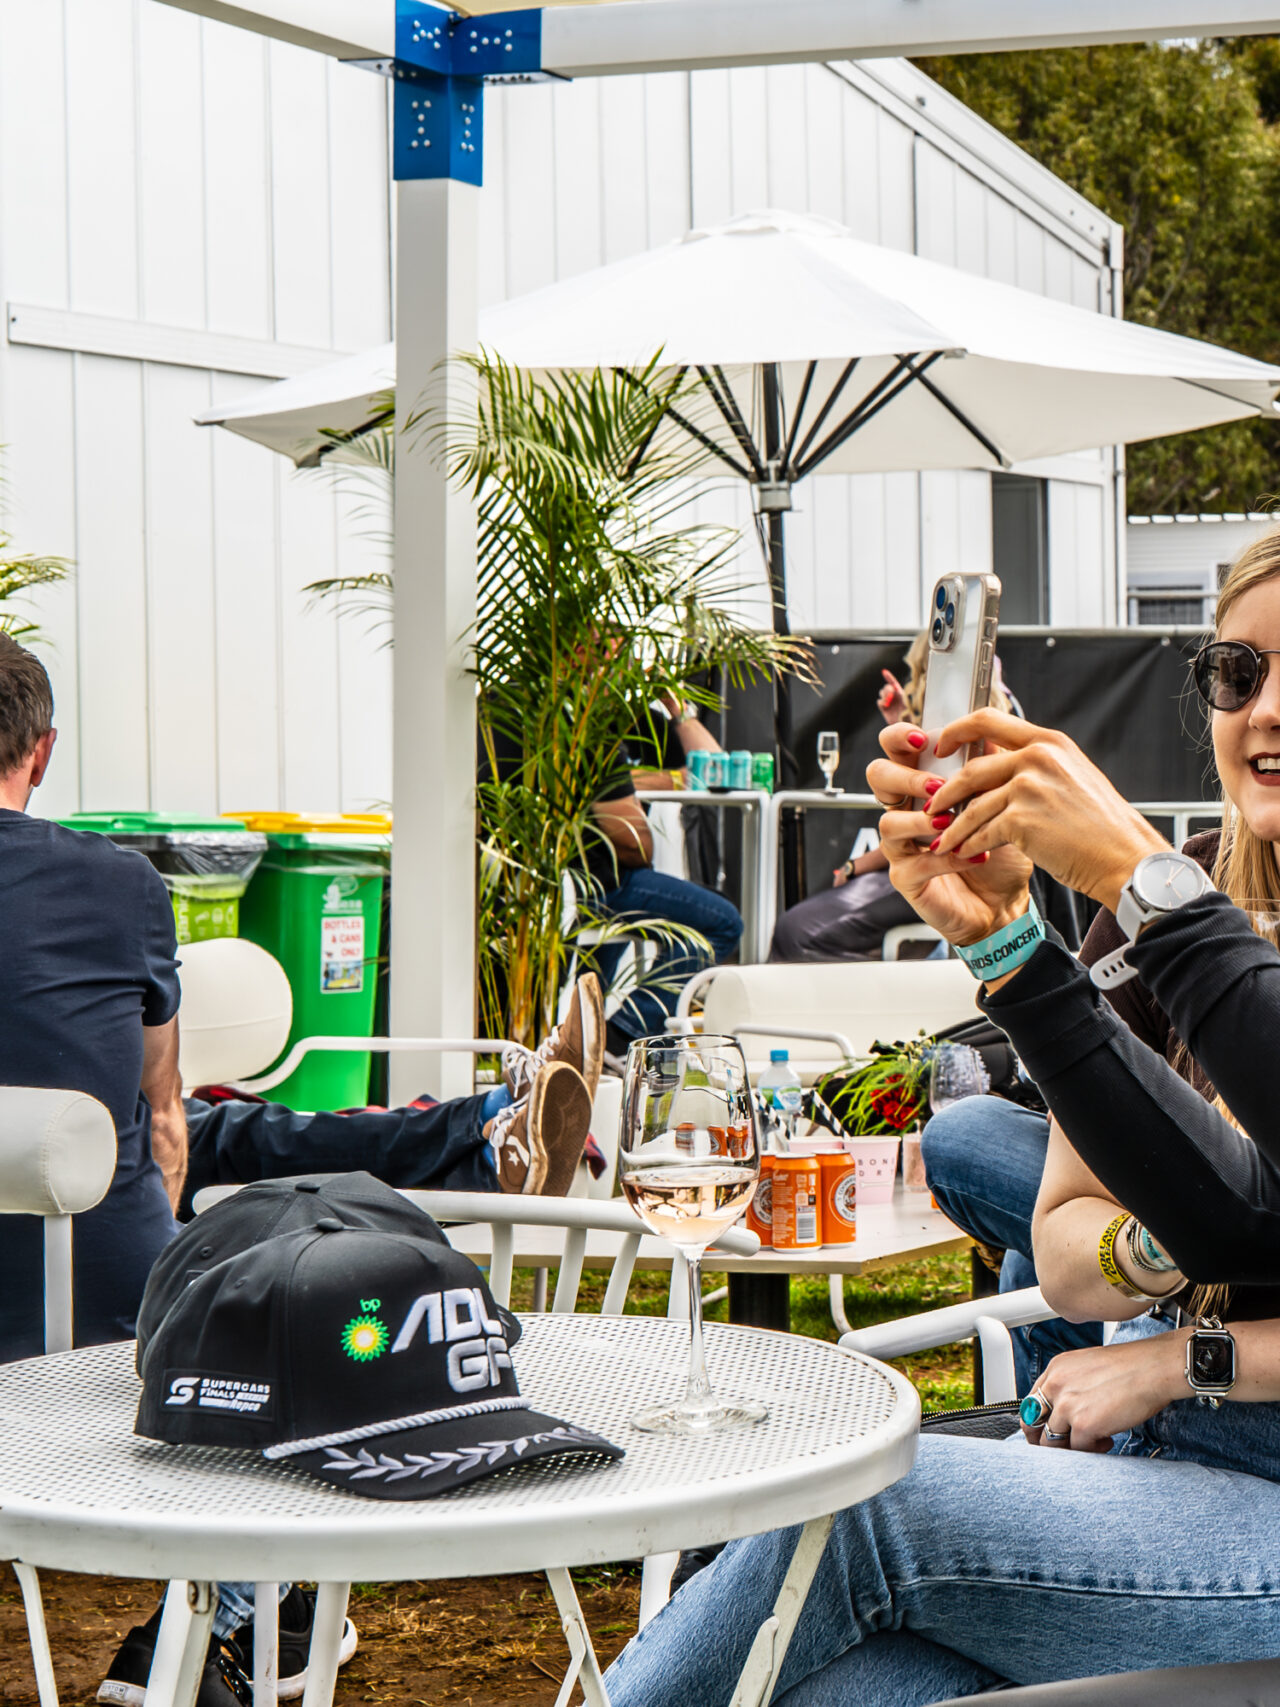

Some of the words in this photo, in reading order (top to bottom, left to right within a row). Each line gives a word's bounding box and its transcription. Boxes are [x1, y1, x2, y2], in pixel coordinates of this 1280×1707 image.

[993, 924, 1040, 963] CONCERT
[360, 1298, 381, 1312] bp
[200, 1388, 235, 1399] FINALS
[202, 1379, 271, 1394] SUPERCARS
[230, 1400, 261, 1412] Repco
